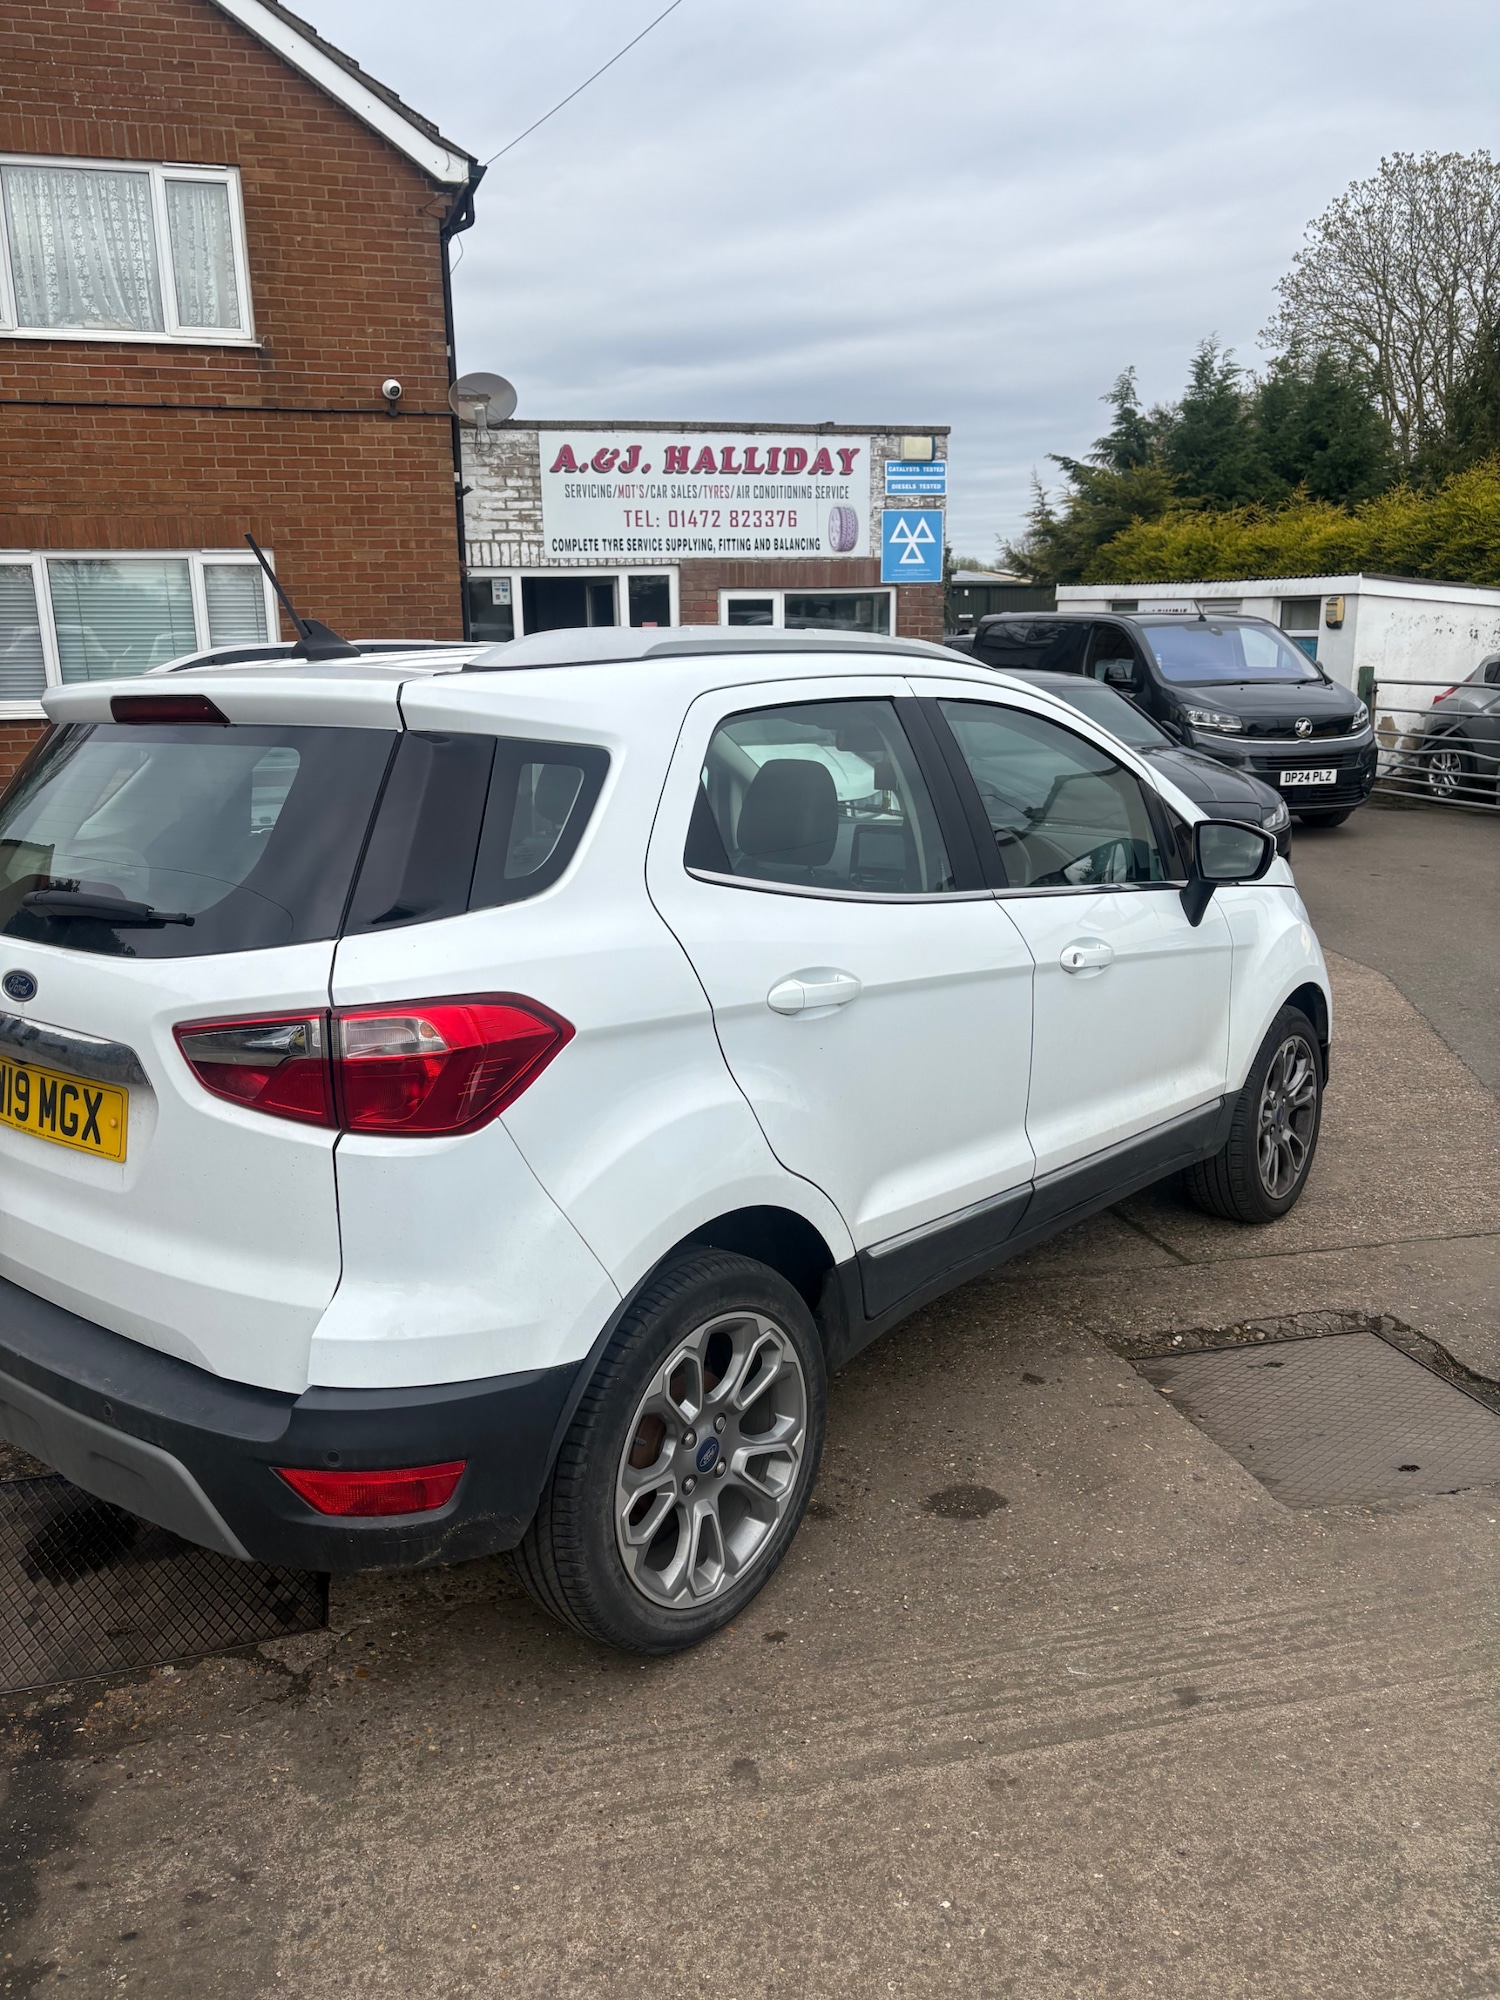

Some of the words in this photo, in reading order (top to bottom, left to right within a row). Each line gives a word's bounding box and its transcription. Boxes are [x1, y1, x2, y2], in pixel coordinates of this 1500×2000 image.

[662, 445, 860, 475] HALLIDAY
[753, 484, 813, 499] CONDITIONING
[815, 485, 850, 499] SERVICE
[623, 509, 661, 528] TEL:
[668, 509, 721, 528] 01472
[729, 509, 798, 528] 823376
[551, 537, 599, 552] COMPLETE
[601, 538, 624, 552] TYRE
[626, 538, 663, 552] SERVICE
[665, 538, 716, 554] SUPPLYING,
[718, 538, 752, 551] FITTING
[754, 538, 771, 551] AND
[773, 538, 821, 551] BALANCING
[1285, 772, 1310, 783] DP24
[1313, 770, 1332, 782] PLZ
[8, 976, 29, 995] Ford
[38, 1077, 103, 1145] MGX
